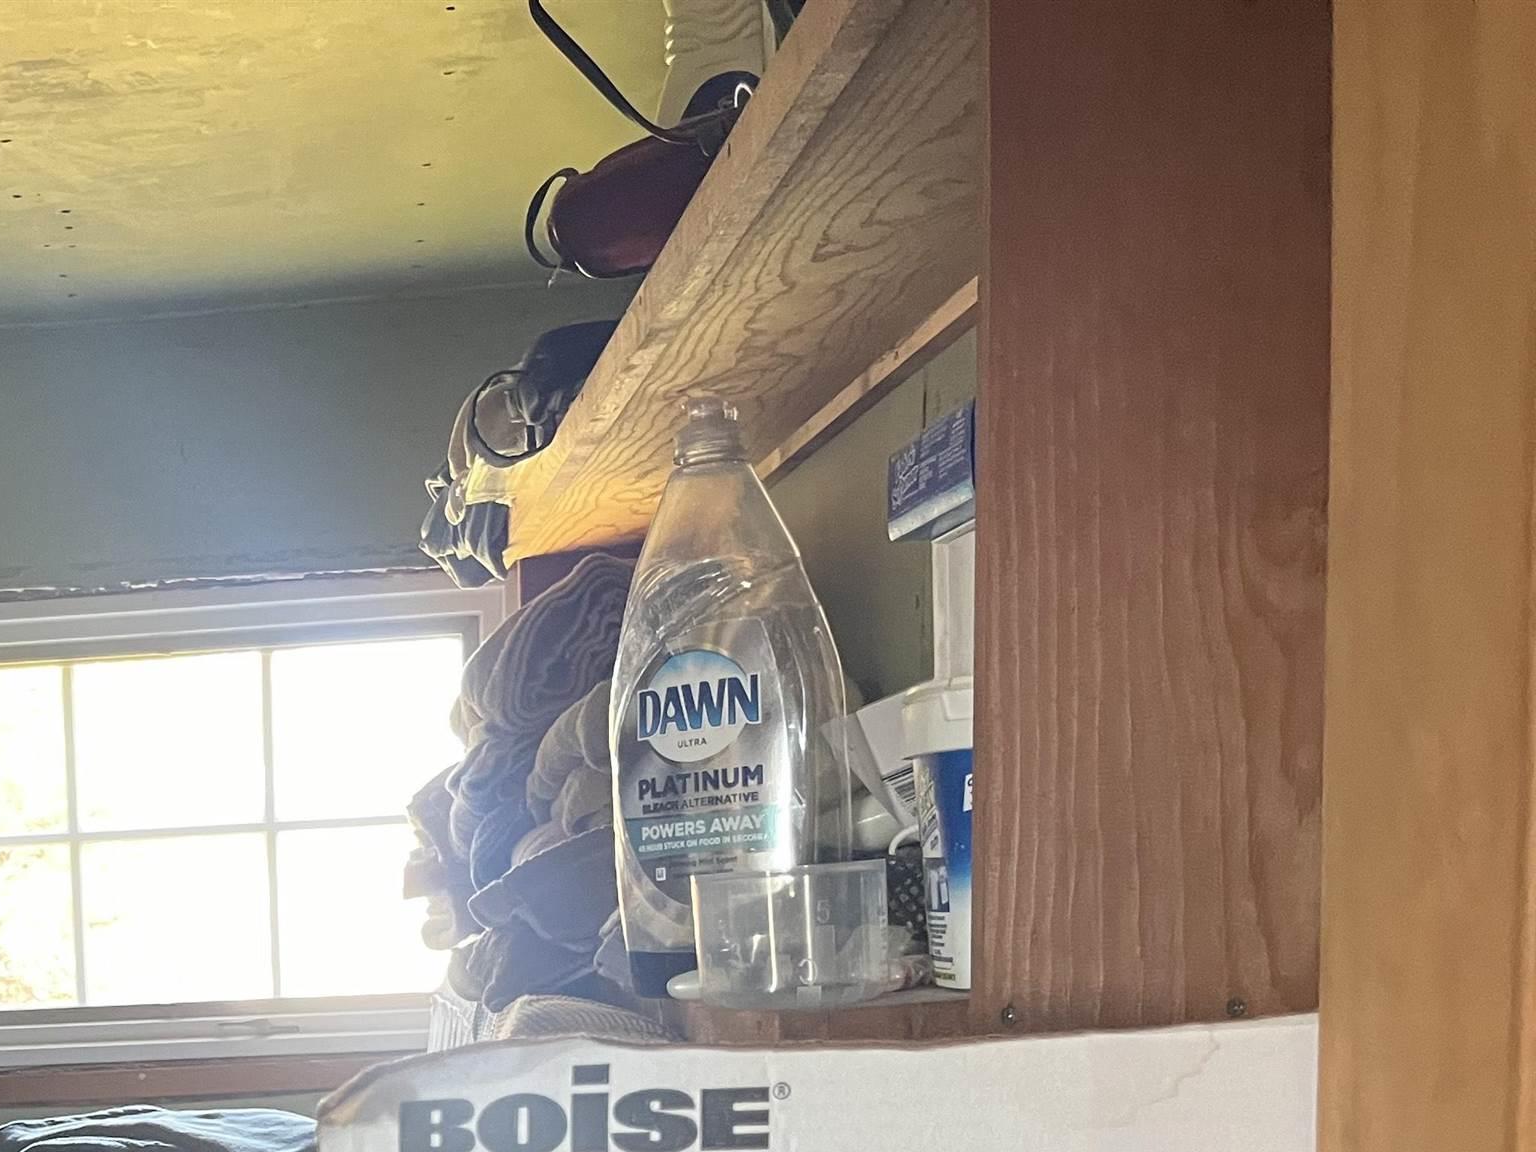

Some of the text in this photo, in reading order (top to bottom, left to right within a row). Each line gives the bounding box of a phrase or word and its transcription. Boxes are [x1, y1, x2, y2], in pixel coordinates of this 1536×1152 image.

[638, 674, 760, 740] DAWN
[677, 737, 707, 748] ULTRA
[638, 764, 764, 801] PLATINUM
[681, 791, 759, 810] ALTERNATIVE
[641, 813, 766, 841] POWERS AWAY
[663, 839, 685, 850] STUCK
[686, 838, 698, 848] ON
[699, 836, 721, 846] FOOD
